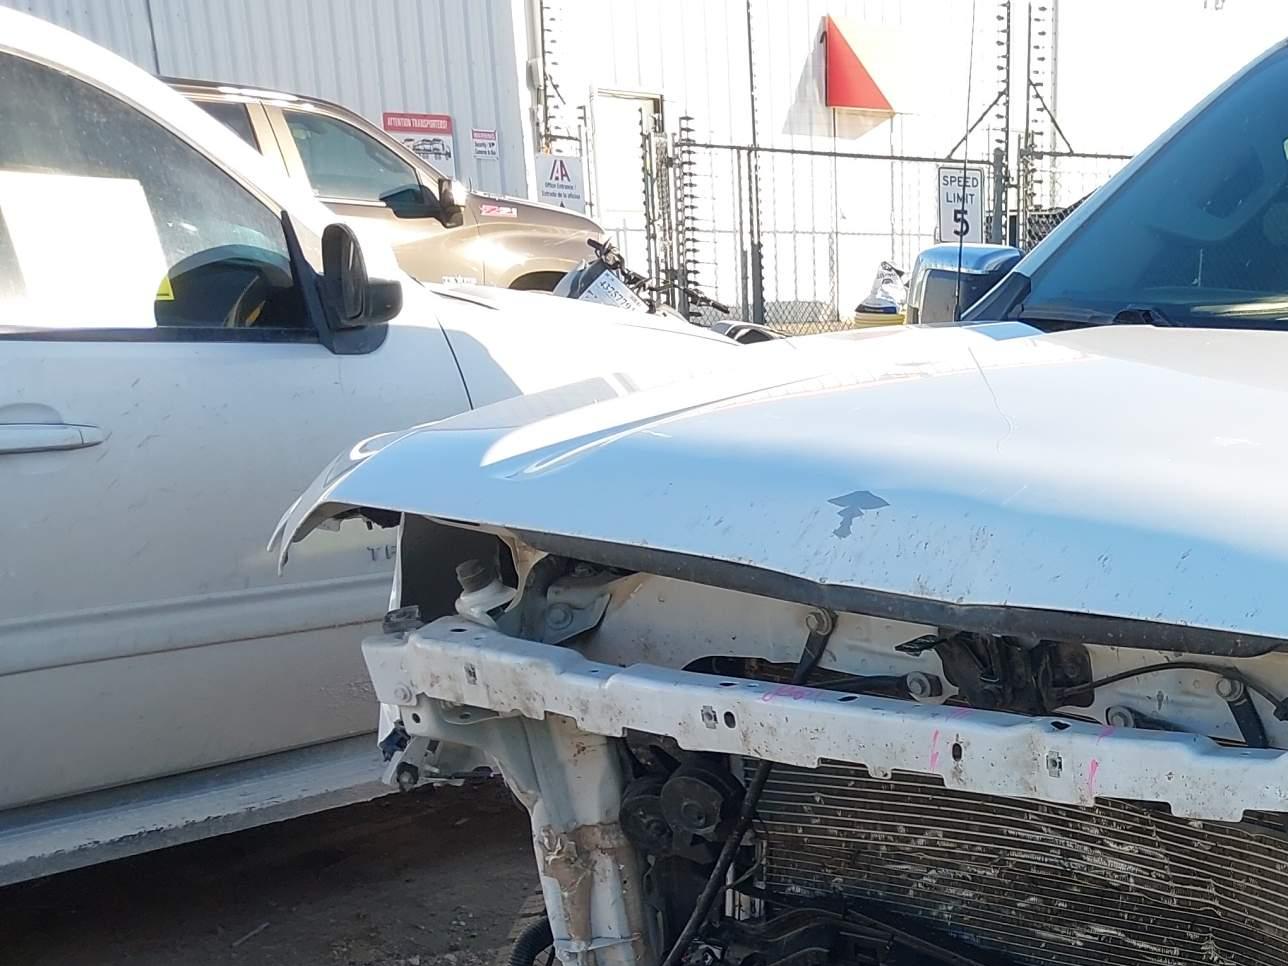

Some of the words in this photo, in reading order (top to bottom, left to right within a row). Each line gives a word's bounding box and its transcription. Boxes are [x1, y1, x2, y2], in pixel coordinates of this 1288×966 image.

[942, 175, 979, 188] SPEED
[945, 191, 975, 205] LIMIT
[953, 209, 970, 236] 5
